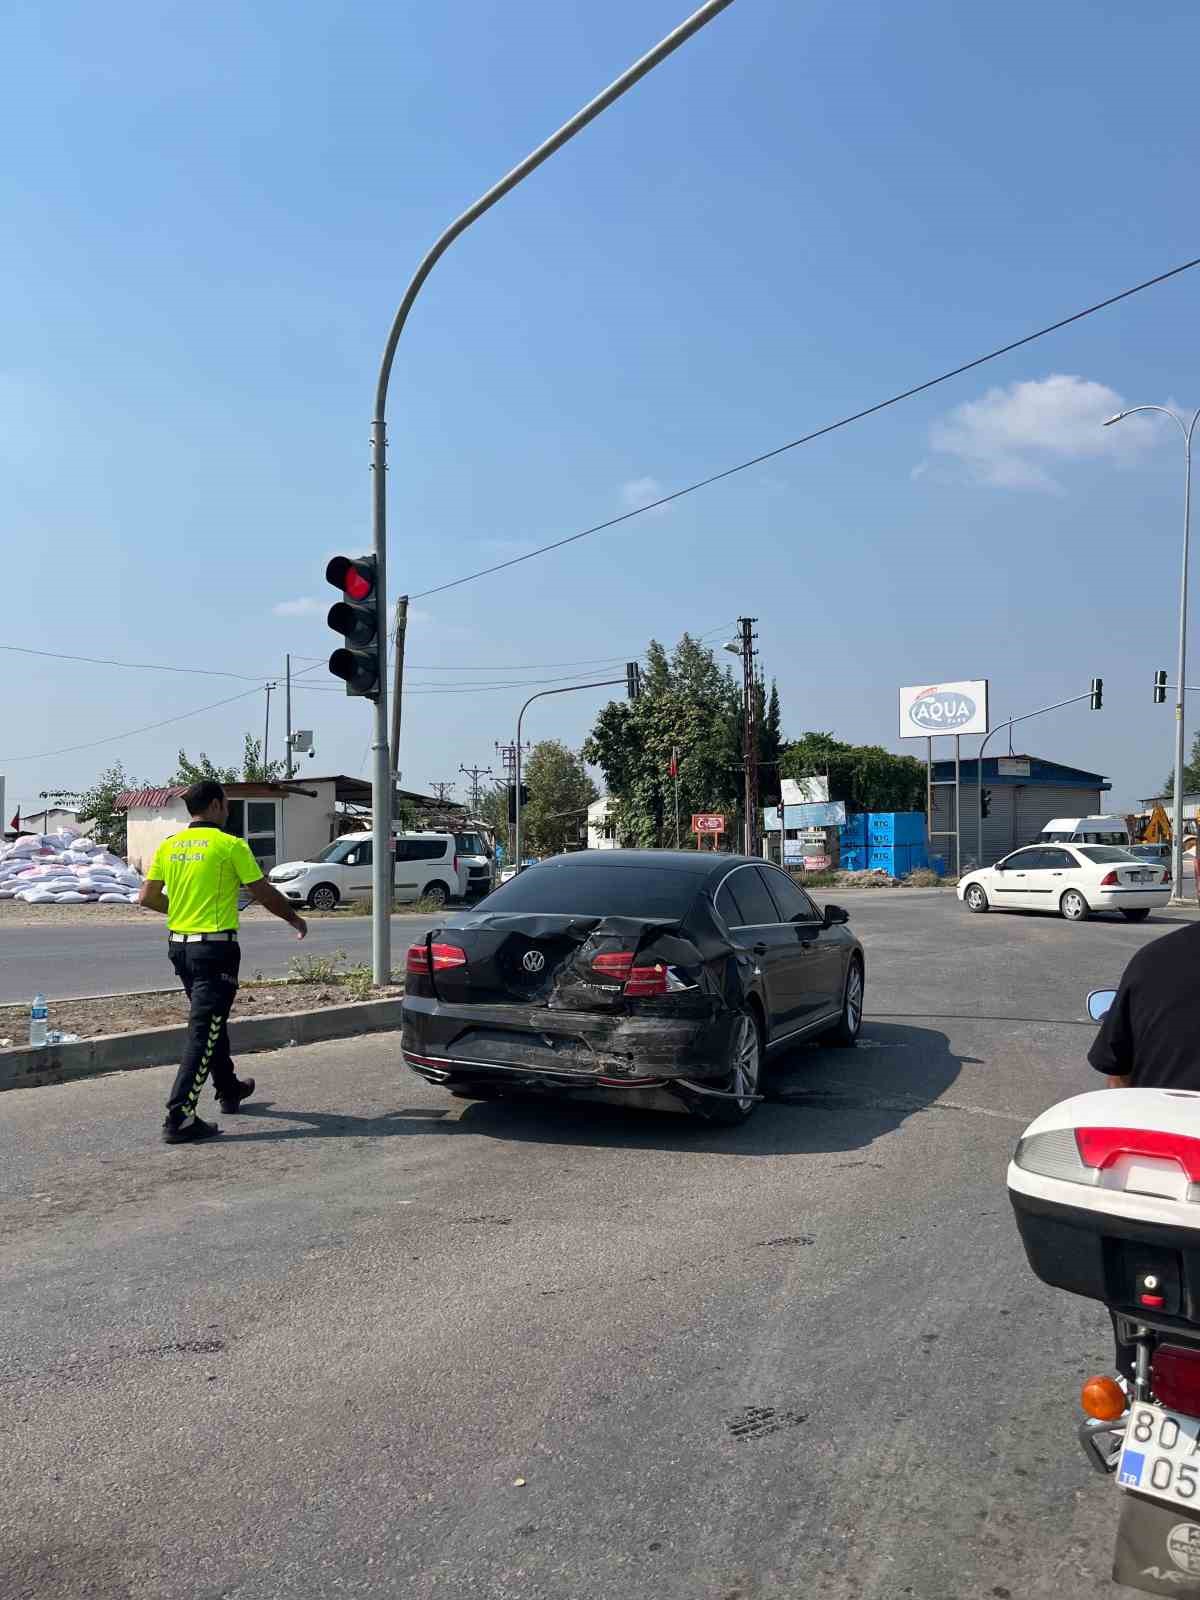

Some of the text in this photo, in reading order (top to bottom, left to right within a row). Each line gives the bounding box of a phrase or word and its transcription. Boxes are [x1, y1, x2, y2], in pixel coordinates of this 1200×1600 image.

[917, 700, 970, 721] AQUA
[1134, 1410, 1181, 1450] 80
[1121, 1472, 1138, 1487] TR
[1150, 1456, 1197, 1499] 05
